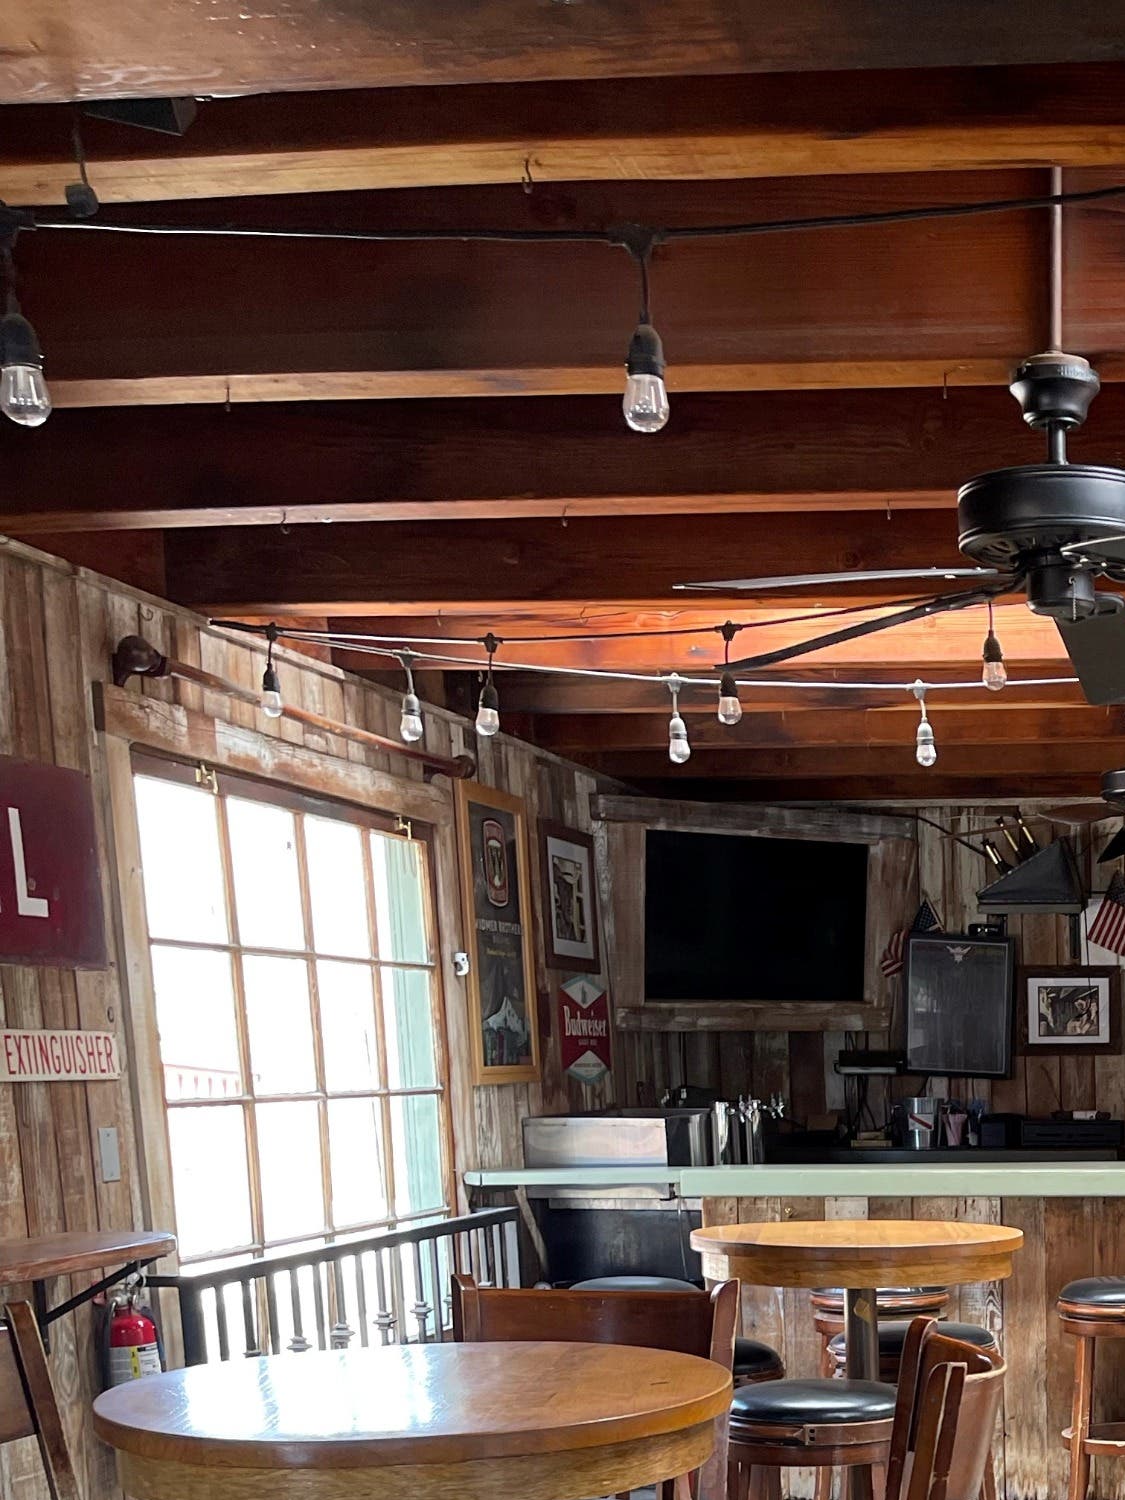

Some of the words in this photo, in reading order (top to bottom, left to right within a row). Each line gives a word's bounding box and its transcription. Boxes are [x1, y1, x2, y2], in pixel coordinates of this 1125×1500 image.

[0, 807, 49, 918] L
[563, 1005, 607, 1037] Budweiser
[4, 1034, 116, 1075] EXTINGUISHER
